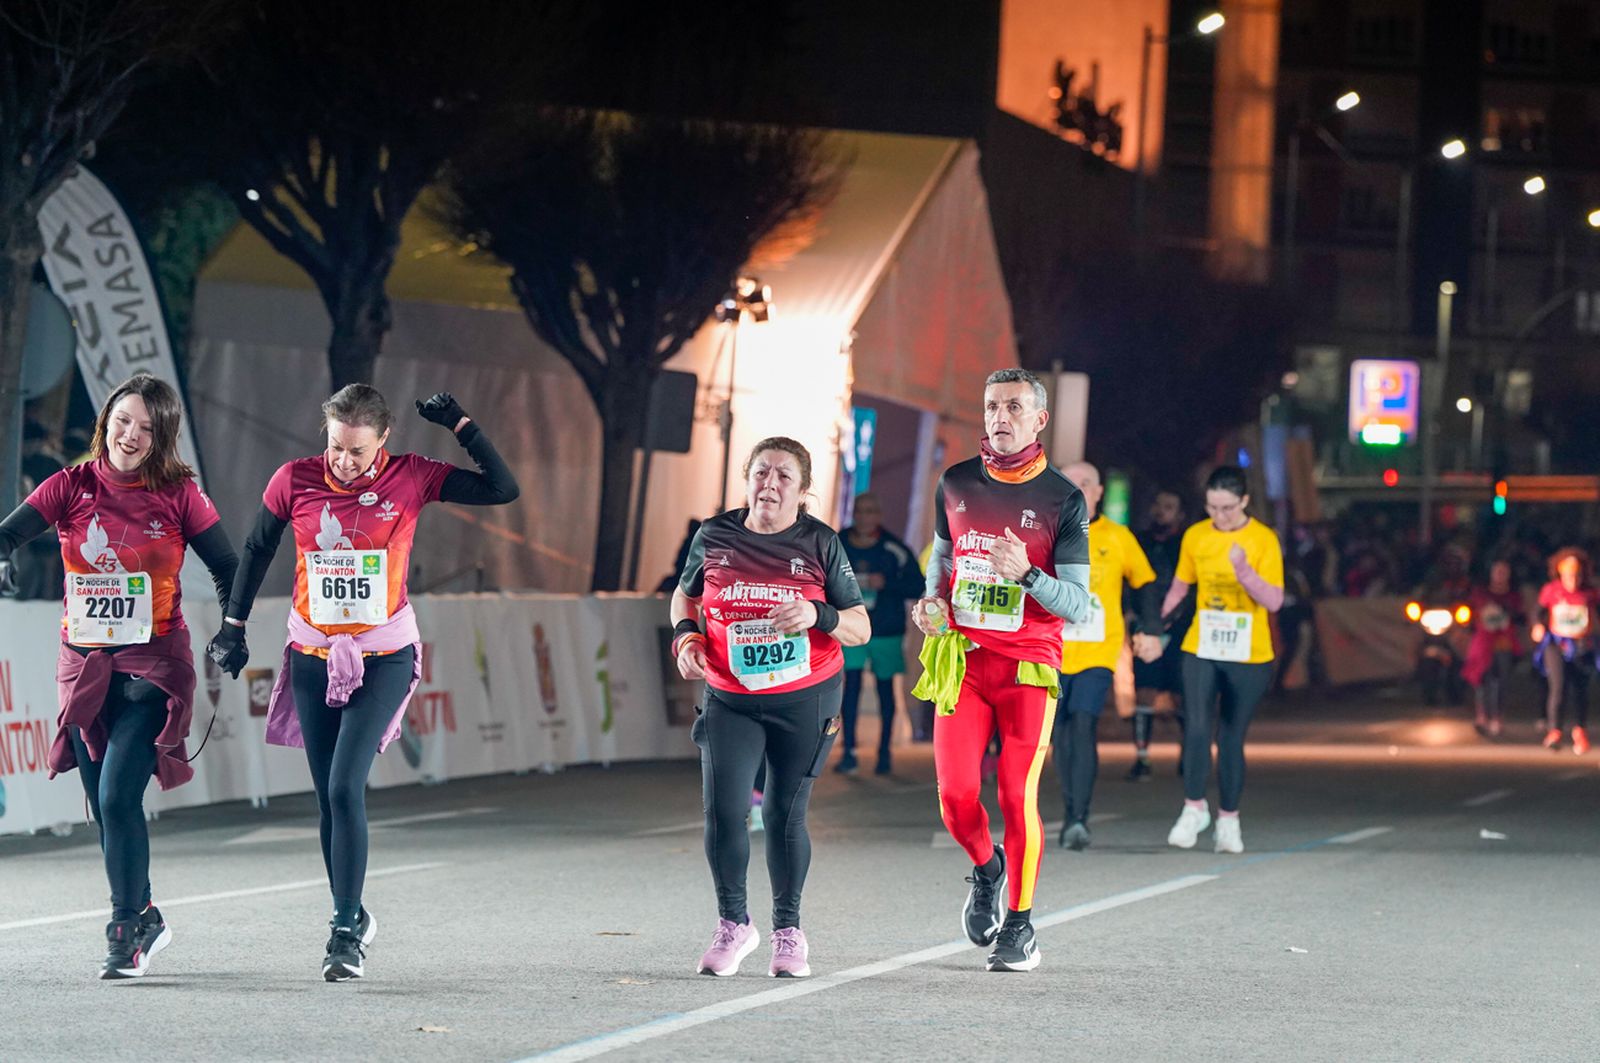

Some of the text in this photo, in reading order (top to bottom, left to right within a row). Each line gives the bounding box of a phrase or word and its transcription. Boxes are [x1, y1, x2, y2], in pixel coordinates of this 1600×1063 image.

[87, 212, 160, 376] EMASA
[53, 223, 117, 392] ACIA
[94, 553, 118, 573] 43
[323, 558, 355, 567] NOCHE DE
[315, 566, 329, 575] SAN
[85, 578, 110, 586] NOCHE
[76, 587, 92, 596] SAN
[322, 577, 371, 600] 6615
[85, 597, 136, 619] 2207
[724, 611, 758, 620] DENTAL
[744, 627, 767, 635] NOCHE
[735, 636, 752, 645] SAN
[1211, 630, 1238, 644] 6117
[743, 641, 796, 667] 9292
